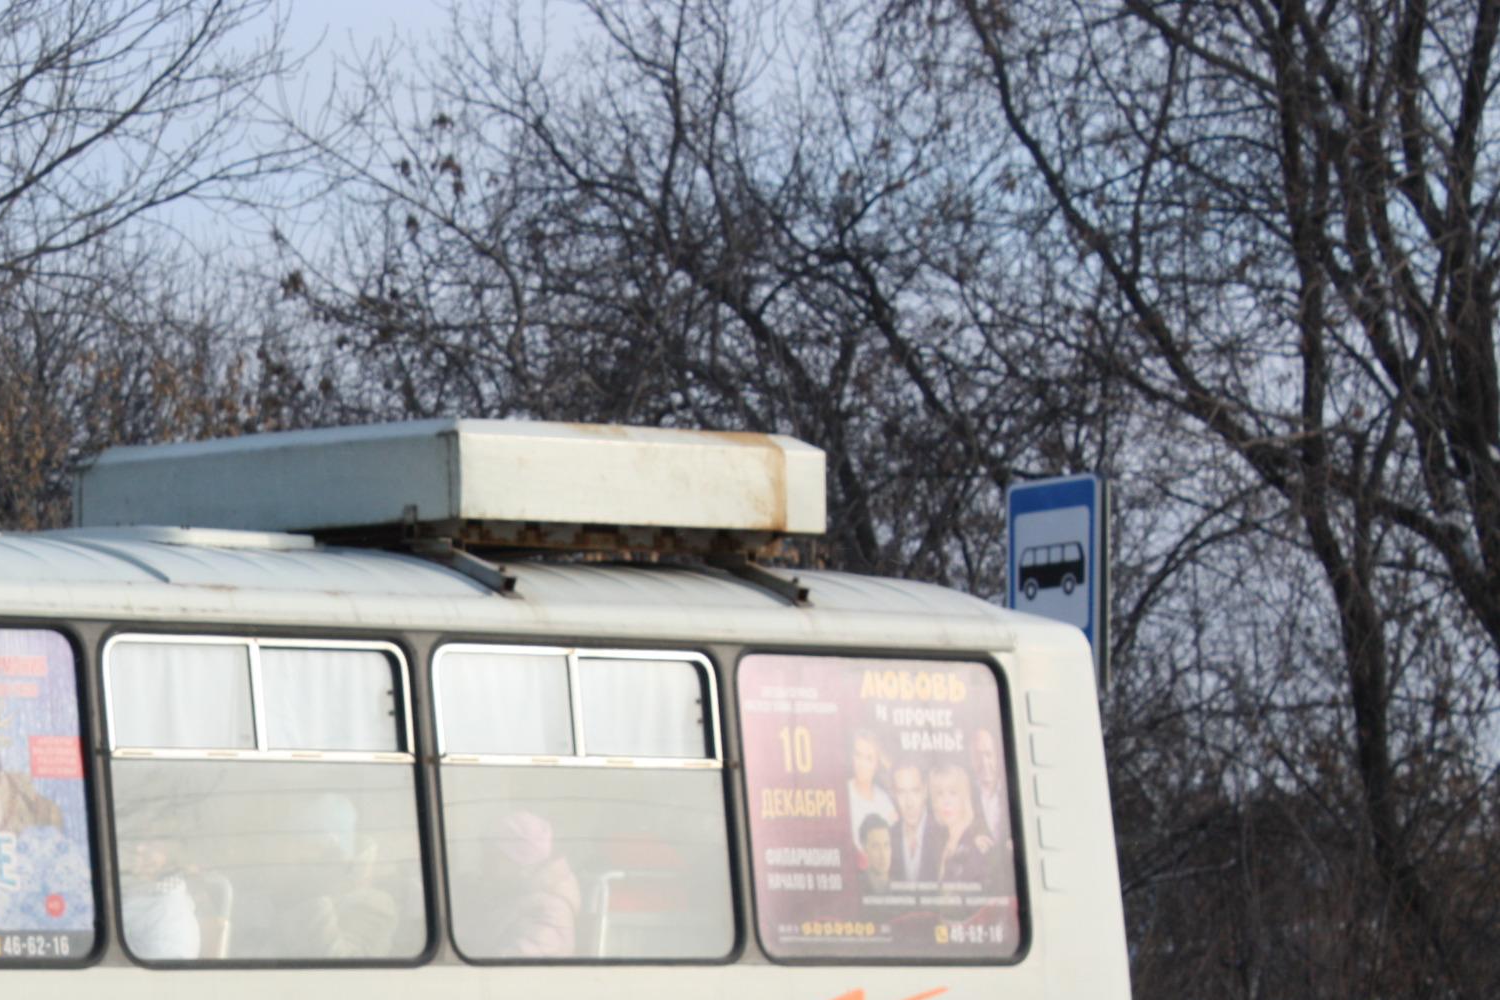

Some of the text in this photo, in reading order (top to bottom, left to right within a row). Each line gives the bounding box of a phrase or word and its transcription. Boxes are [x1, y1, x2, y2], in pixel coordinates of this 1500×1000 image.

[860, 670, 966, 703] ЛЮБОВЬ
[779, 726, 813, 774] 10
[761, 788, 837, 819] ДЕКАБРЯ
[3, 935, 70, 956] 46-62-16
